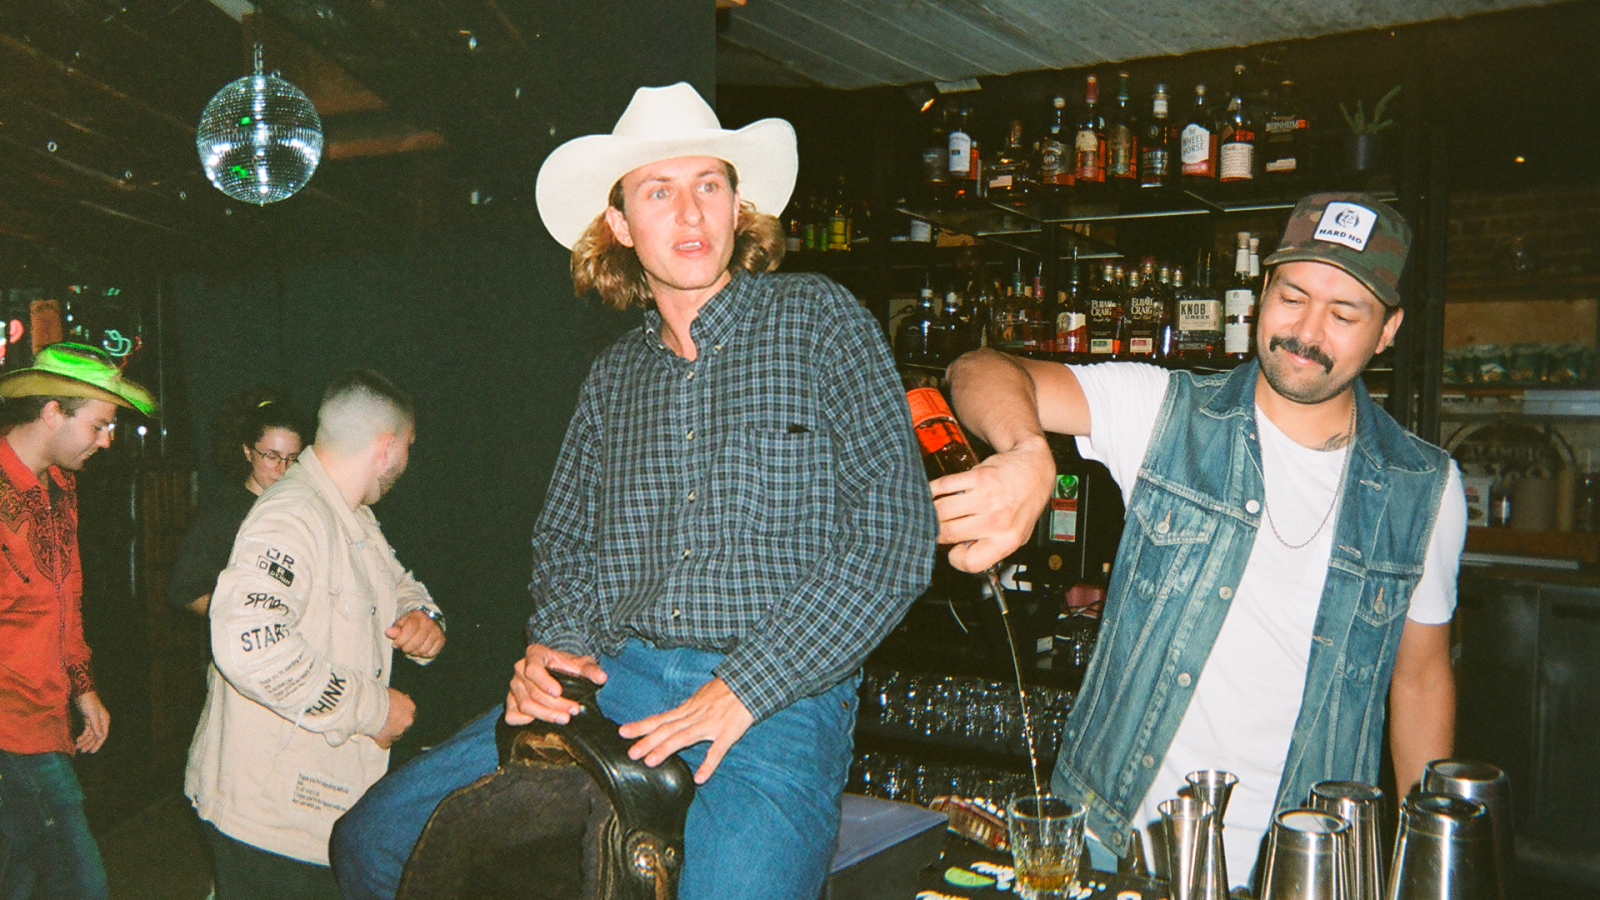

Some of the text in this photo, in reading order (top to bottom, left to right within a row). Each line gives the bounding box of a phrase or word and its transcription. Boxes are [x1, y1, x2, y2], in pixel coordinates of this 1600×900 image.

[1182, 135, 1204, 147] WHEEL
[1182, 143, 1204, 157] HORSE
[1319, 229, 1363, 245] HARD NO
[1090, 308, 1113, 317] CRAIG
[1130, 306, 1153, 316] CRAIG
[1180, 303, 1206, 316] KNOB
[304, 671, 347, 716] THINK
